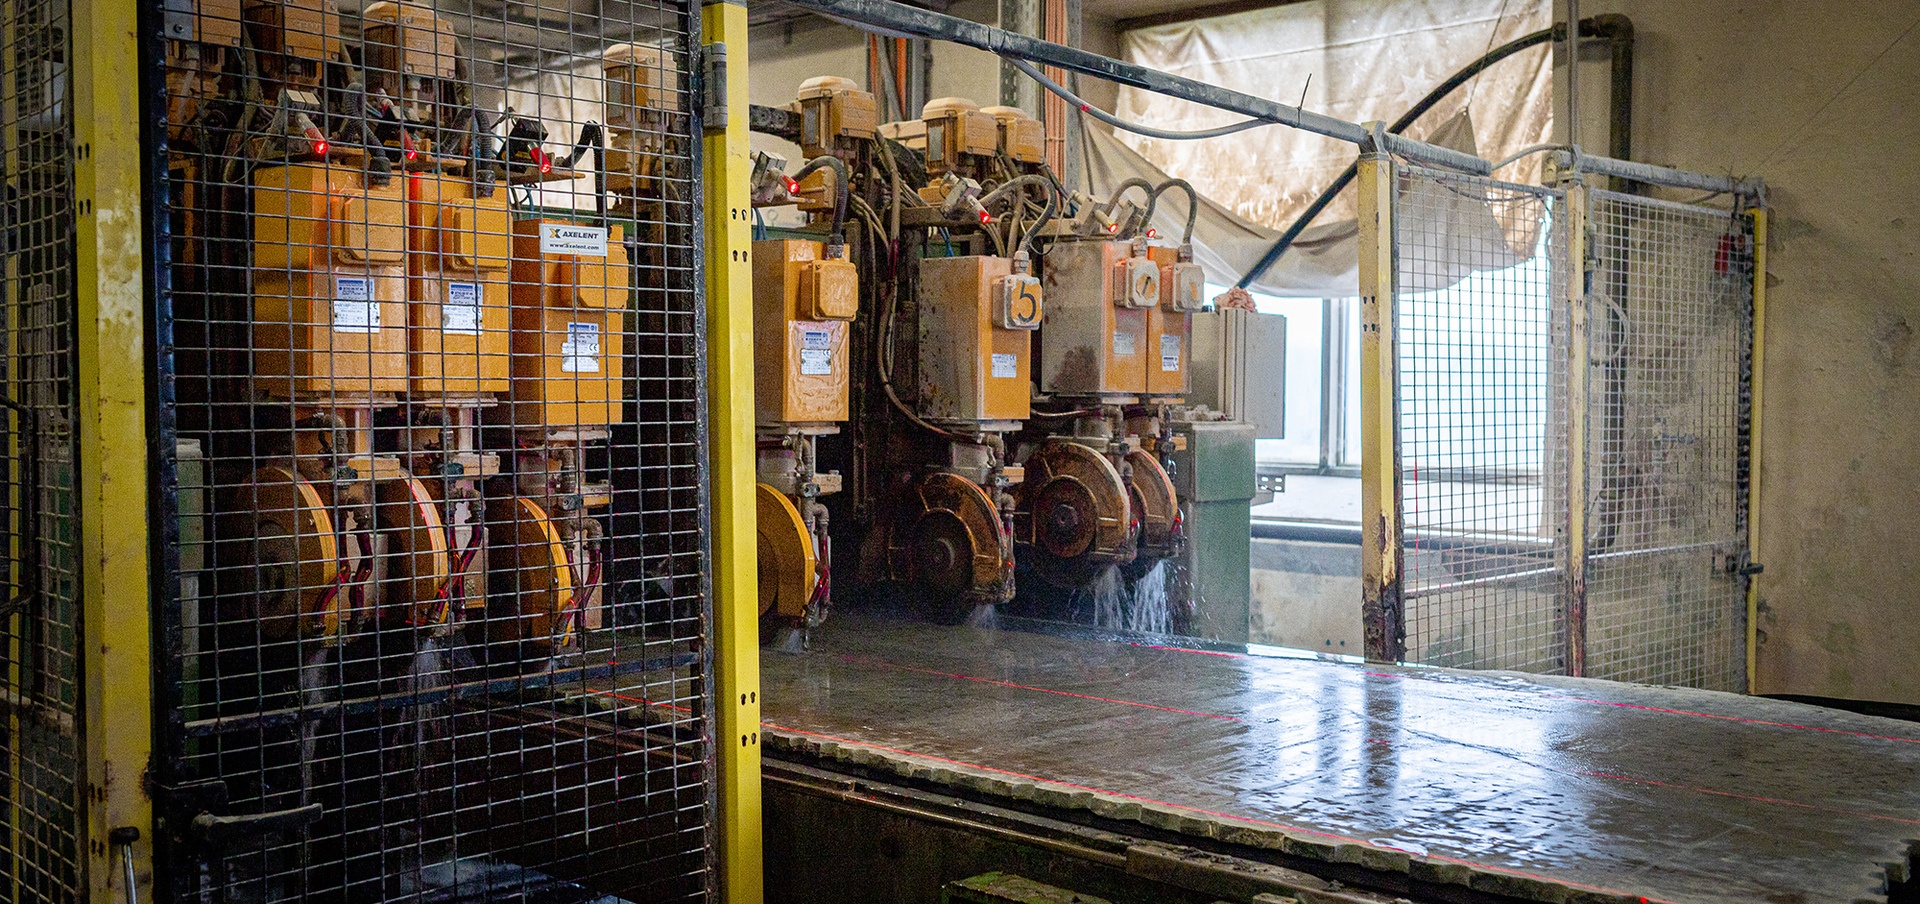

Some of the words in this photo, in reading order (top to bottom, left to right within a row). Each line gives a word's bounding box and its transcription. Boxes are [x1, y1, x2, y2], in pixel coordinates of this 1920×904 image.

[562, 231, 599, 240] AXELENT
[549, 243, 600, 251] www.axelent.com
[1017, 281, 1037, 324] 5
